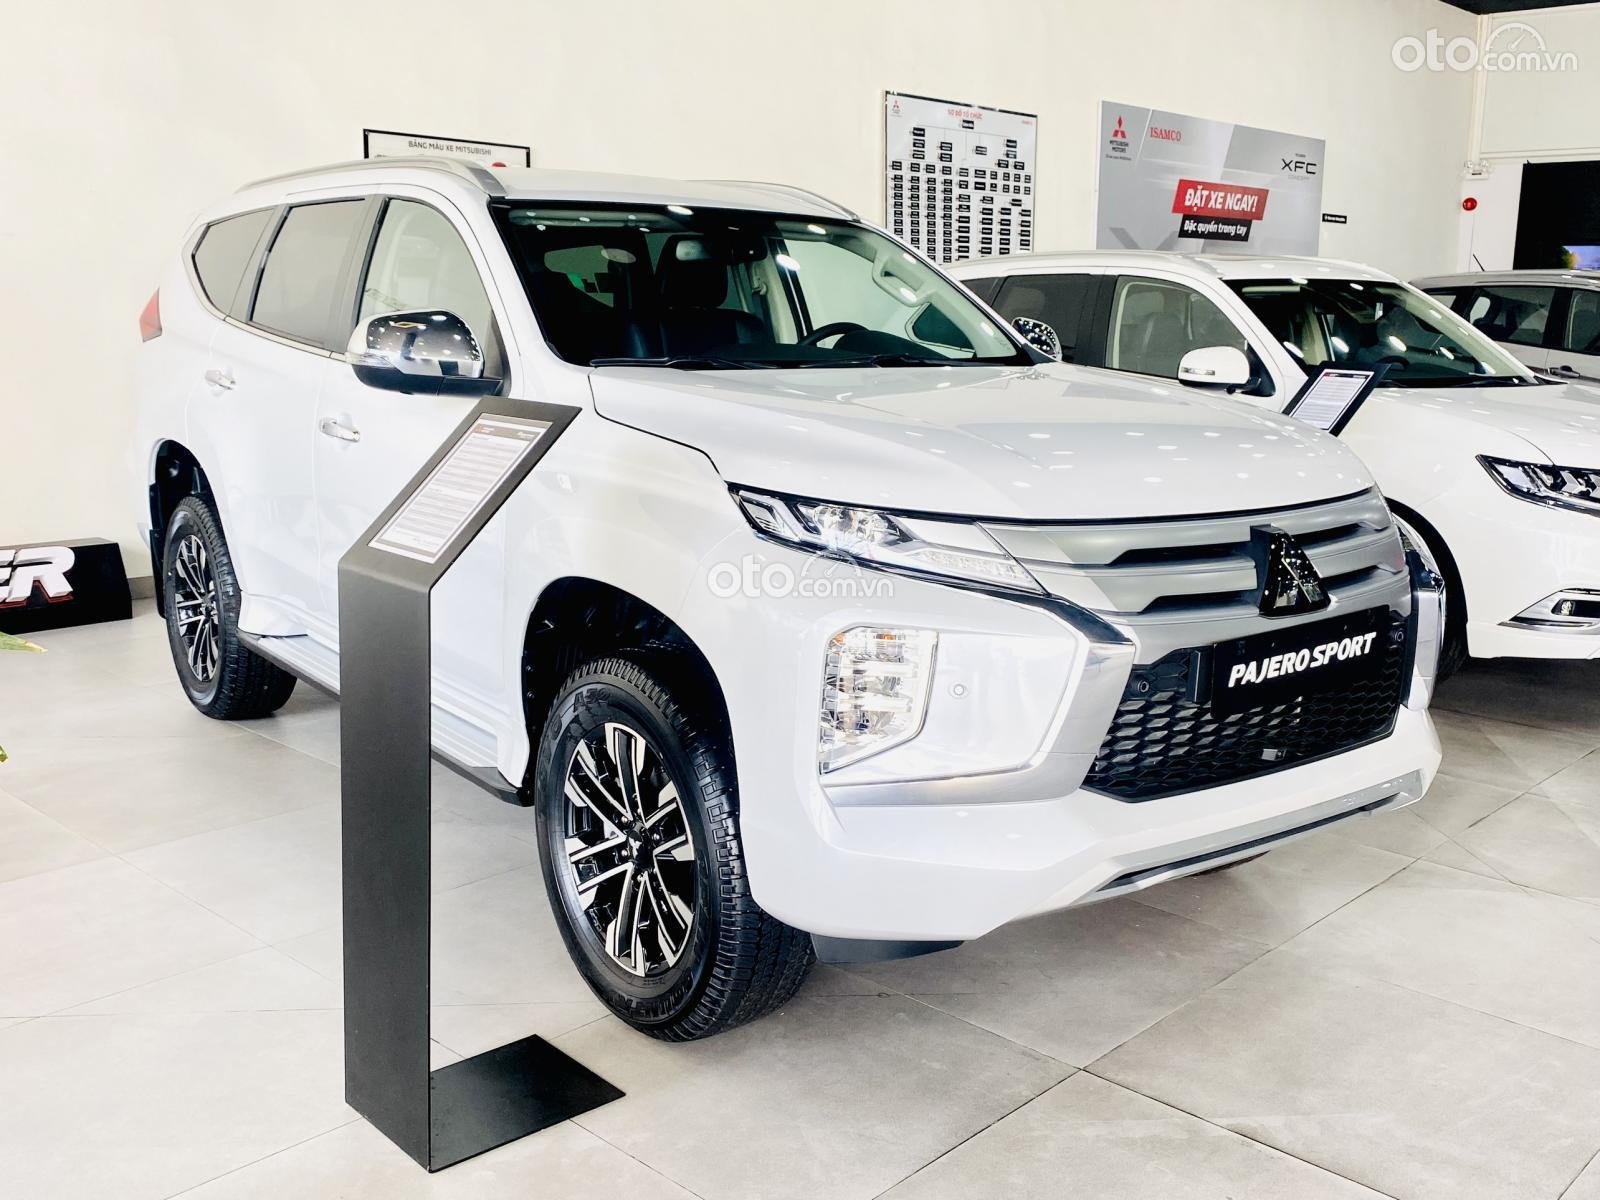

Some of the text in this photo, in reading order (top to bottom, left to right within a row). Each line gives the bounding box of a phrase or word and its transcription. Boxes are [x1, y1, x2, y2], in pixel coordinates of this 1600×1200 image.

[1150, 127, 1182, 142] ISAMCO
[408, 138, 428, 150] BẢNG
[446, 144, 454, 152] XE
[455, 145, 492, 156] MITSUBISHI
[1281, 158, 1317, 175] XFC
[1184, 185, 1258, 213] ĐẶT XE NGAY!
[1218, 223, 1236, 237] trong
[1236, 224, 1248, 237] tay
[1228, 631, 1377, 688] PAJERO SPORT
